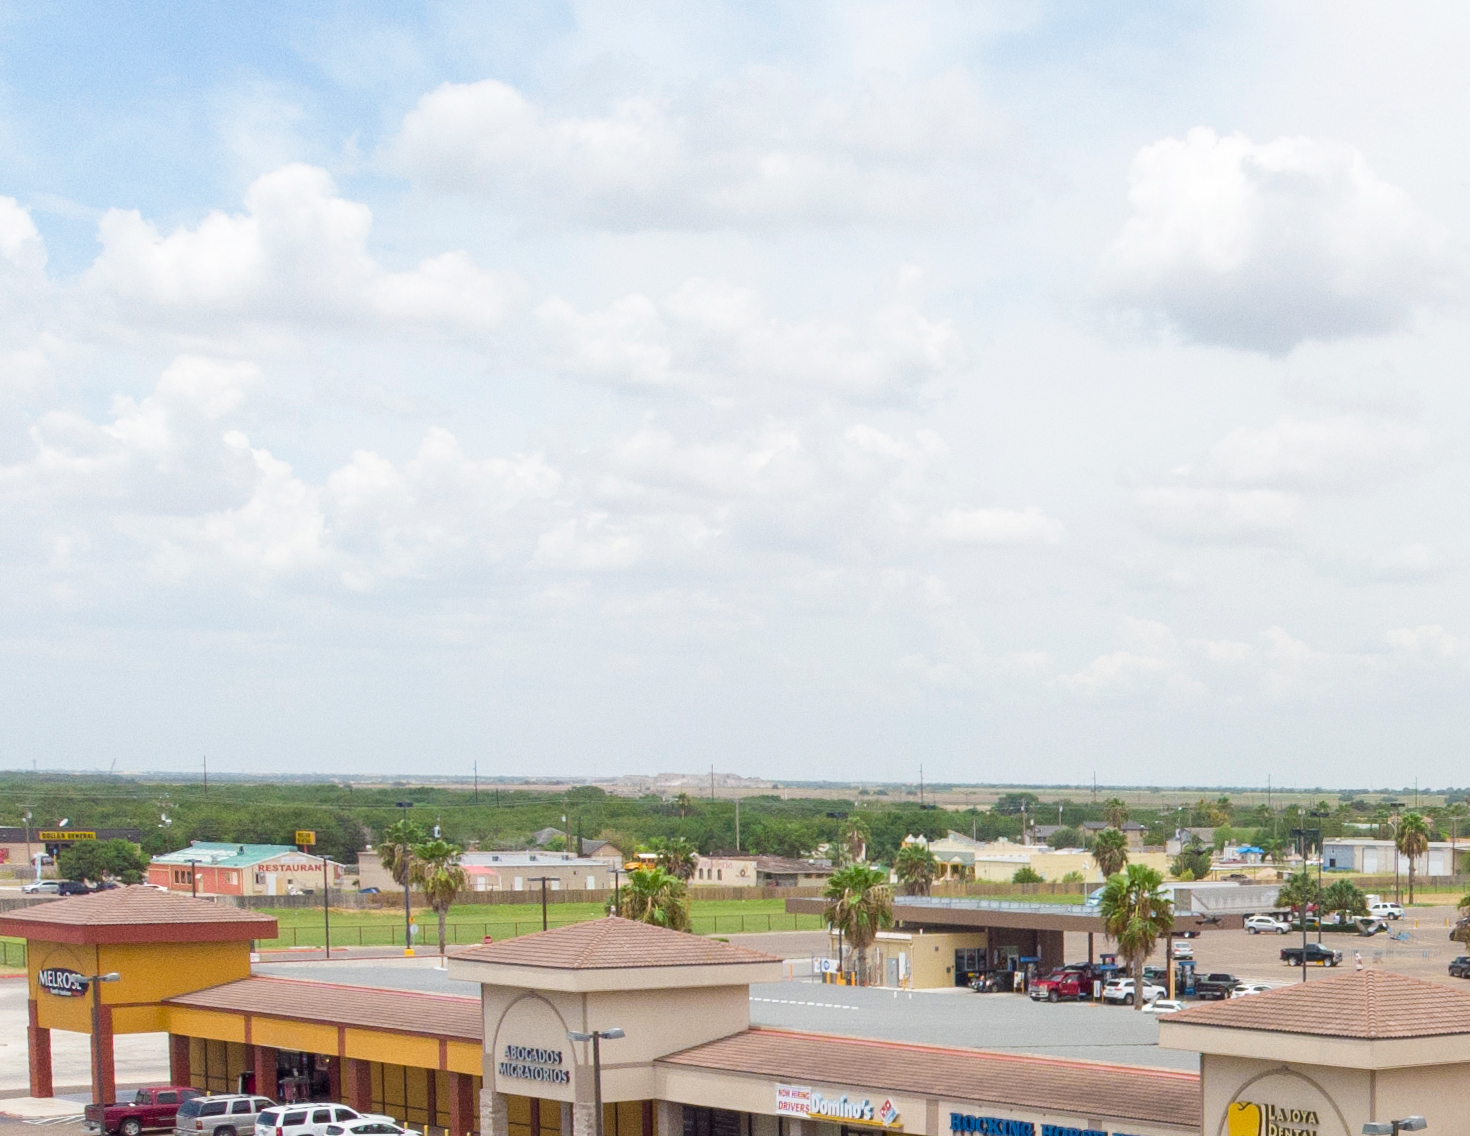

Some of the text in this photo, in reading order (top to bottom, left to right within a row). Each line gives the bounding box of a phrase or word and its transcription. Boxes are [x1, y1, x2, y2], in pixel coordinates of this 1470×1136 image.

[504, 1045, 562, 1064] ABOGADOS
[499, 1062, 570, 1083] MIGRATORIOS
[778, 1088, 810, 1100] NOW HIRING
[778, 1101, 810, 1113] DRIVERS
[812, 1093, 874, 1121] Domino's
[1288, 1109, 1319, 1124] JOYA
